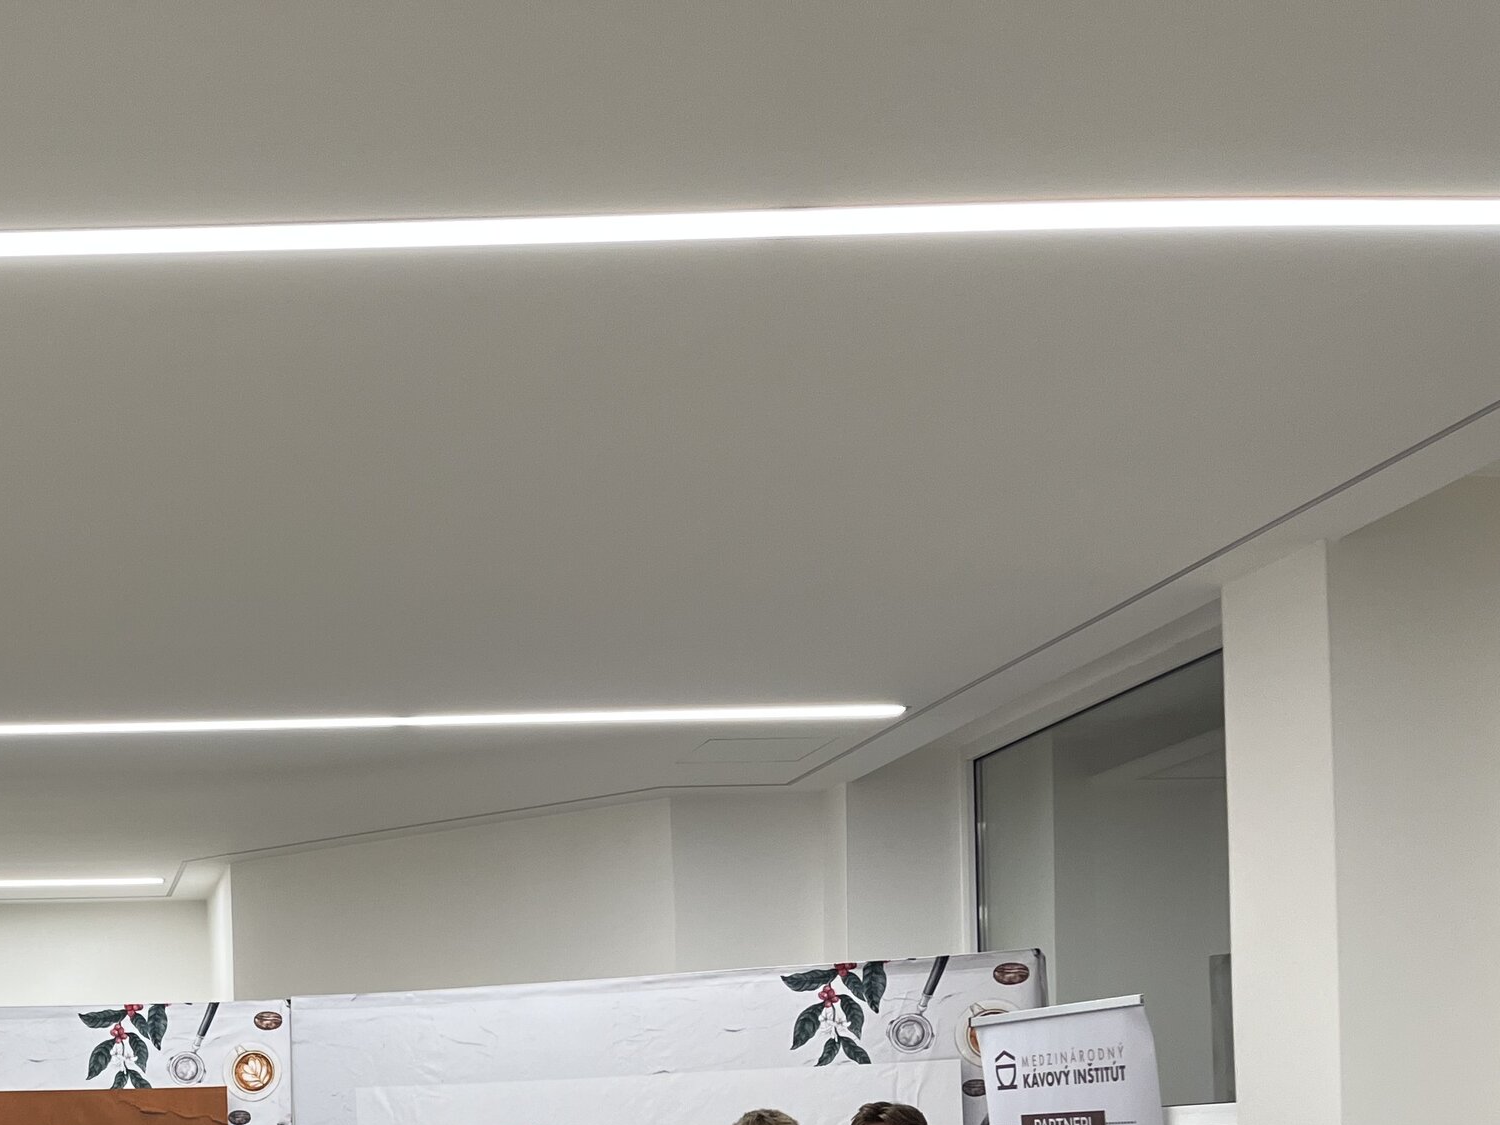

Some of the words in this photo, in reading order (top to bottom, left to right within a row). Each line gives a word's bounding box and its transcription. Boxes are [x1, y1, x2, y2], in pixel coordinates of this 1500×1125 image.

[1021, 1042, 1125, 1067] MEDZINÁRODNÝ
[1023, 1065, 1070, 1088] KÁVOVÝ
[1073, 1061, 1126, 1085] INŠTITÚT
